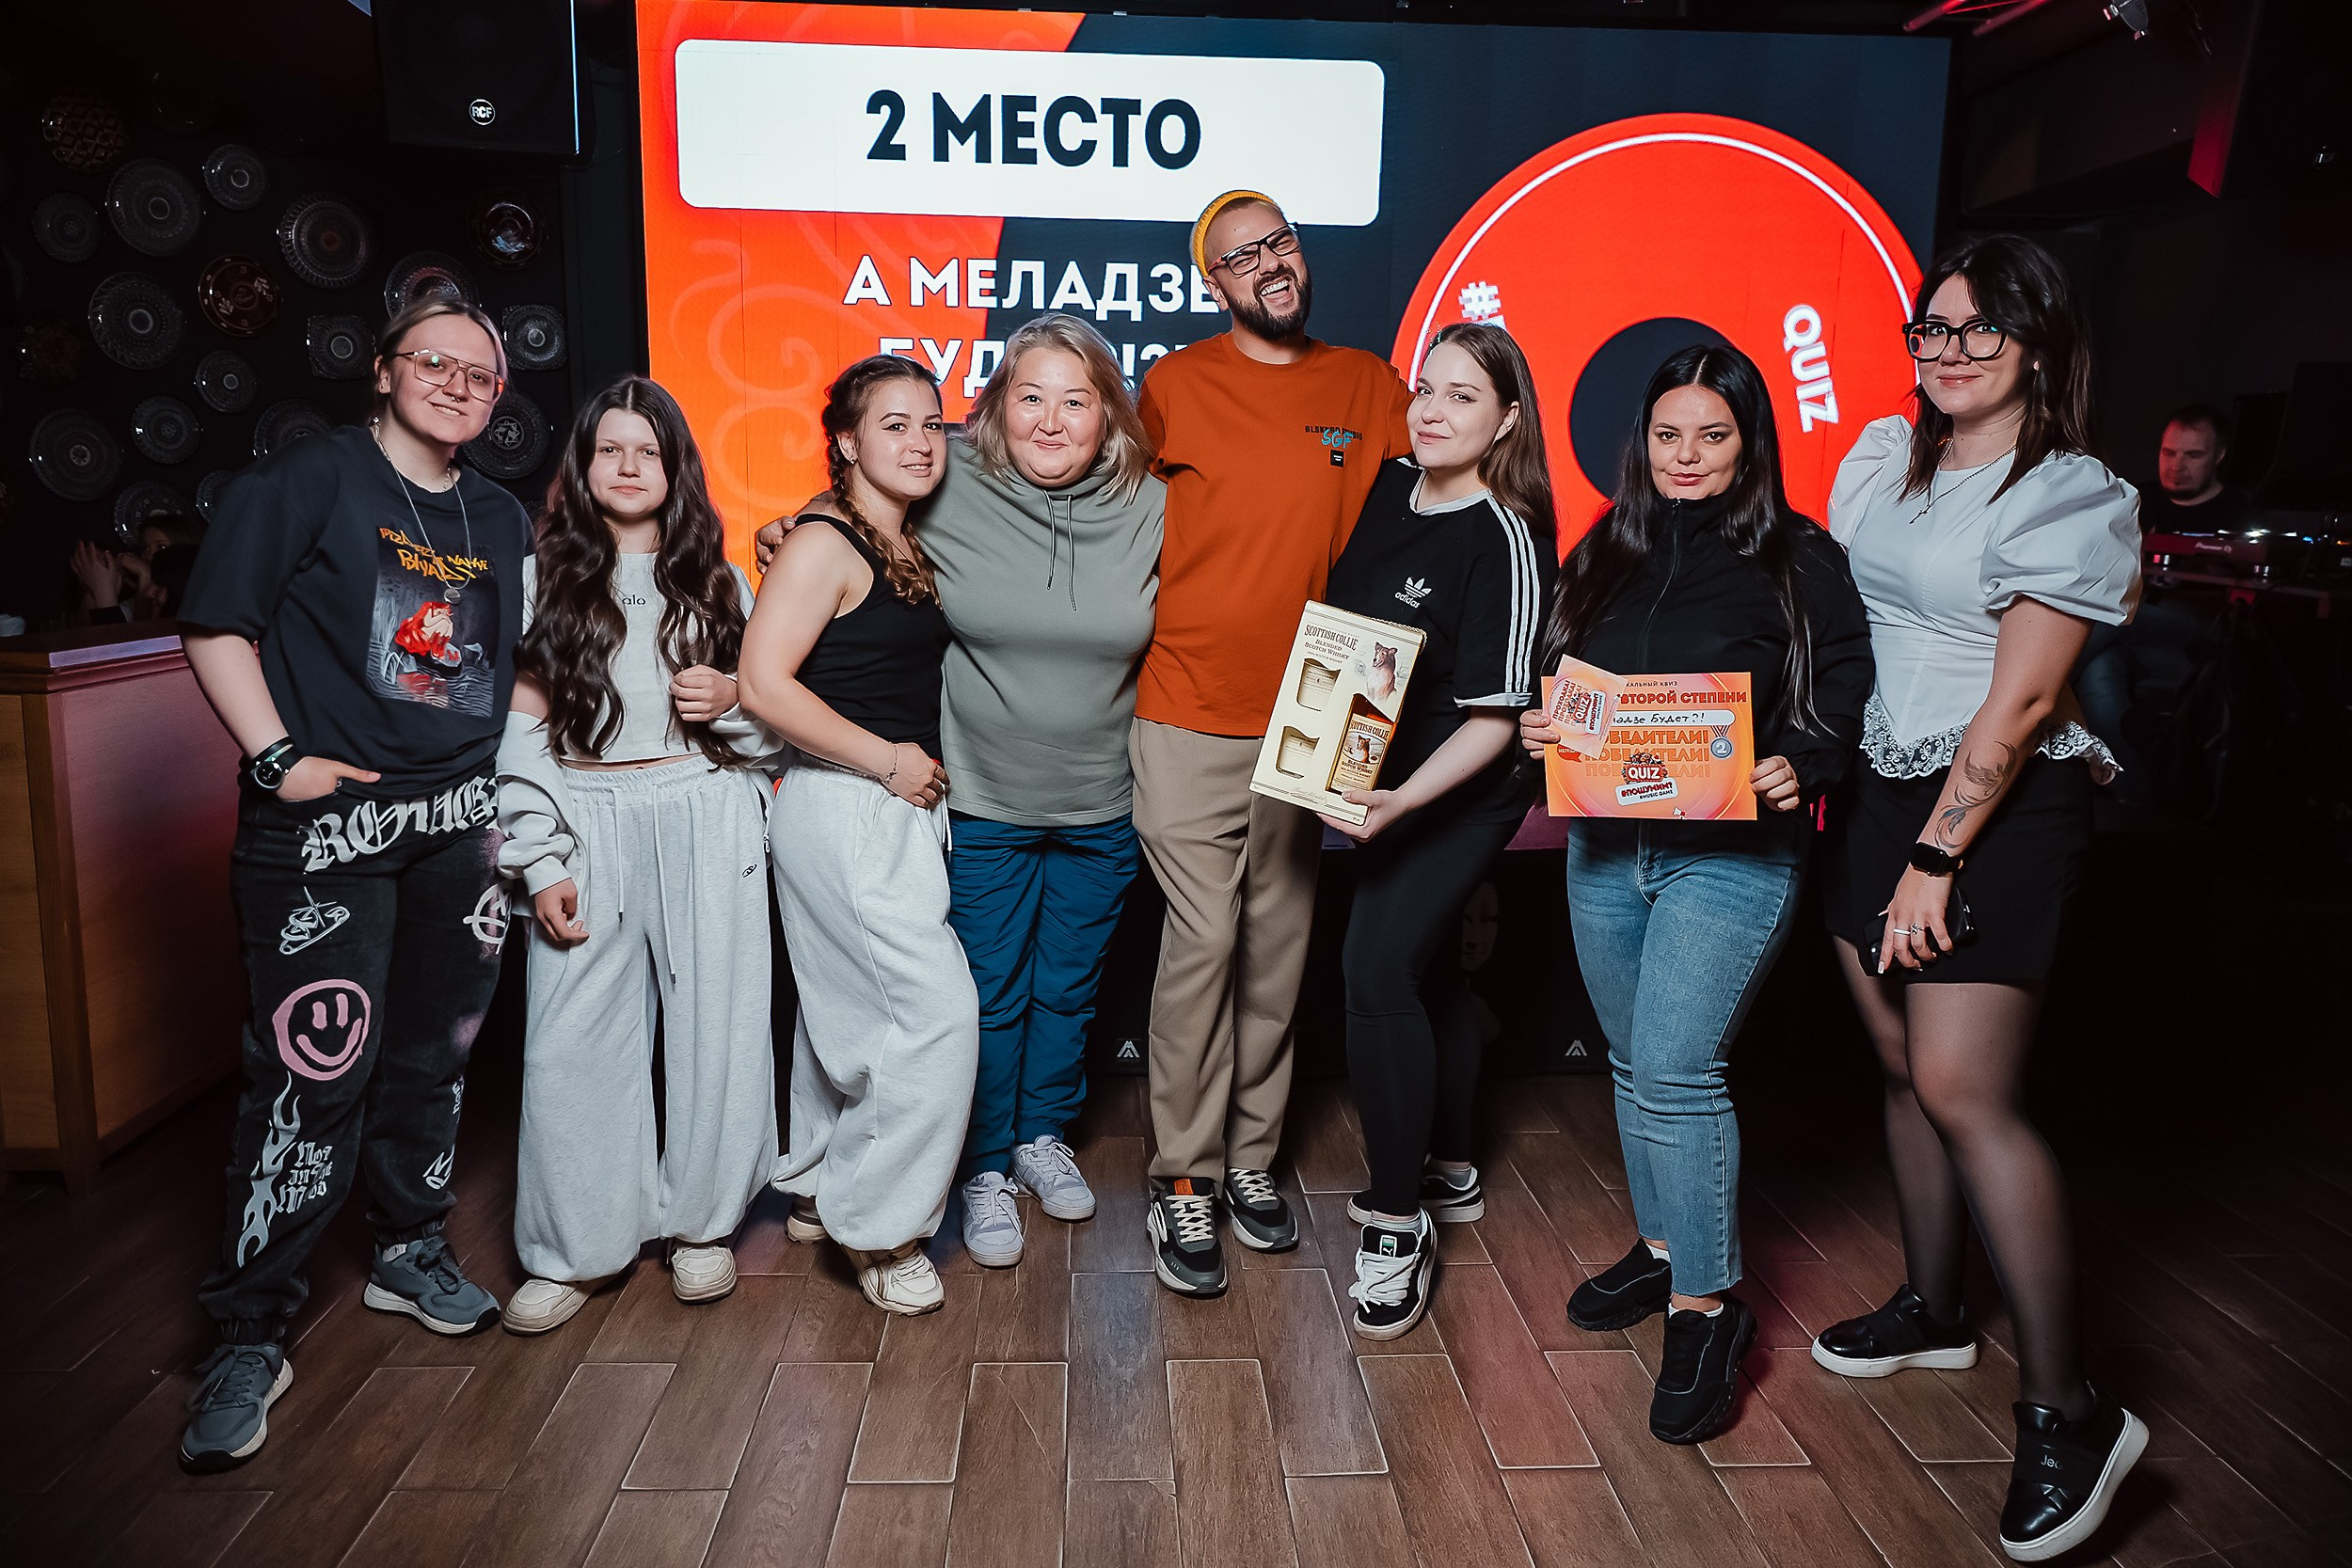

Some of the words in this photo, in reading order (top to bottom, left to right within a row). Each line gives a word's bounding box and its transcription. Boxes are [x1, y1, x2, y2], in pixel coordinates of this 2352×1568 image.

[471, 105, 492, 119] RCF
[866, 89, 906, 161] 2
[931, 92, 1201, 170] МЕСТО
[843, 255, 892, 307] А
[1783, 304, 1839, 433] QUIZ
[1394, 592, 1421, 609] adidas
[1304, 624, 1336, 641] SCOTTISH
[1335, 632, 1359, 651] COLLIE
[1575, 695, 1589, 720] QUIZ
[1620, 690, 1677, 705] ВТОРОЙ
[1680, 691, 1747, 704] СТЕПЕНИ
[1605, 730, 1709, 746] БЕДИТЕЛИ!
[1628, 767, 1661, 780] QUIZ
